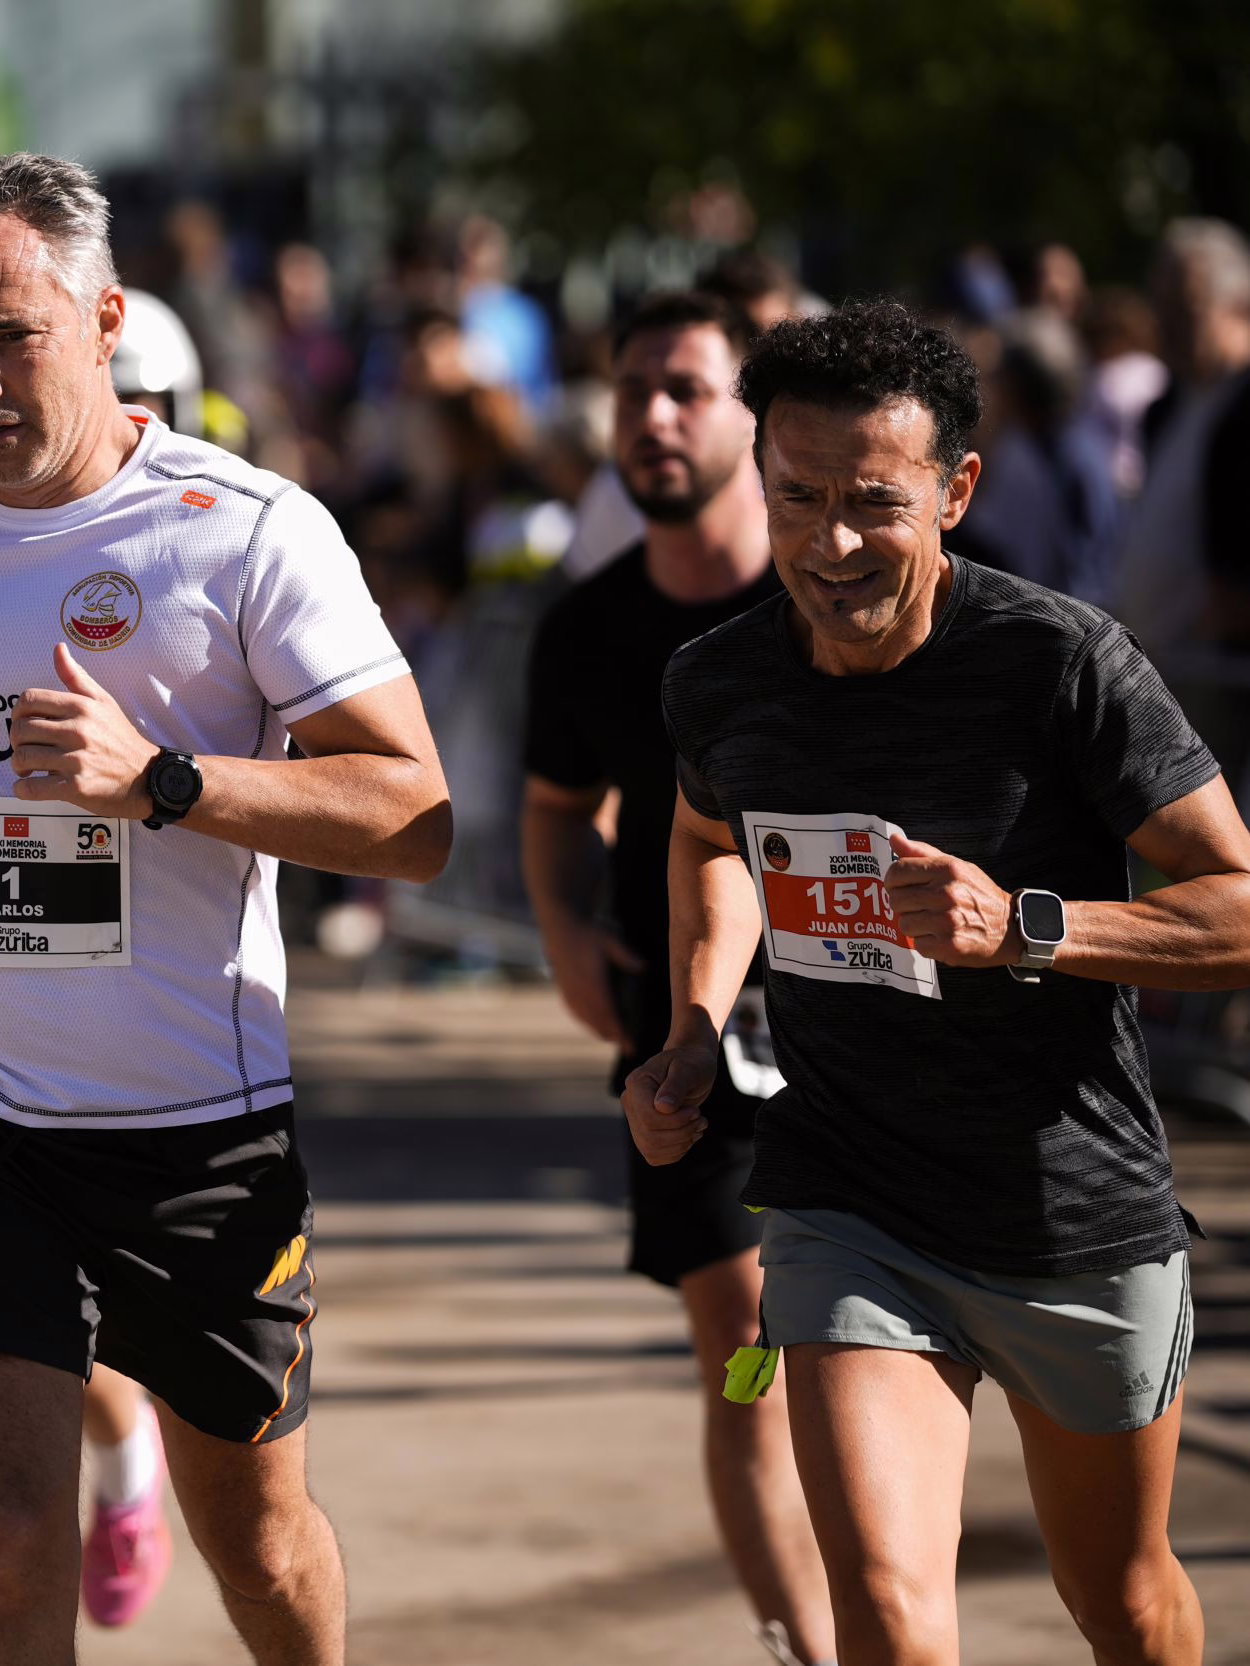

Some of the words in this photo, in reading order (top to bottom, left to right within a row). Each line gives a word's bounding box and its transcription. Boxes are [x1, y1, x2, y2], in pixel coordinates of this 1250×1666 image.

[80, 615, 119, 624] BOMBEROS
[99, 640, 109, 648] DE
[77, 823, 112, 849] 50
[6, 839, 47, 849] MEMORIAL
[829, 855, 848, 863] XXXI
[1, 866, 20, 900] 1
[806, 881, 894, 921] 1519
[808, 920, 849, 934] JUAN
[854, 921, 897, 941] CARLOS
[847, 941, 873, 954] Grupo
[849, 948, 893, 970] zurita
[1119, 1384, 1155, 1398] adidas
